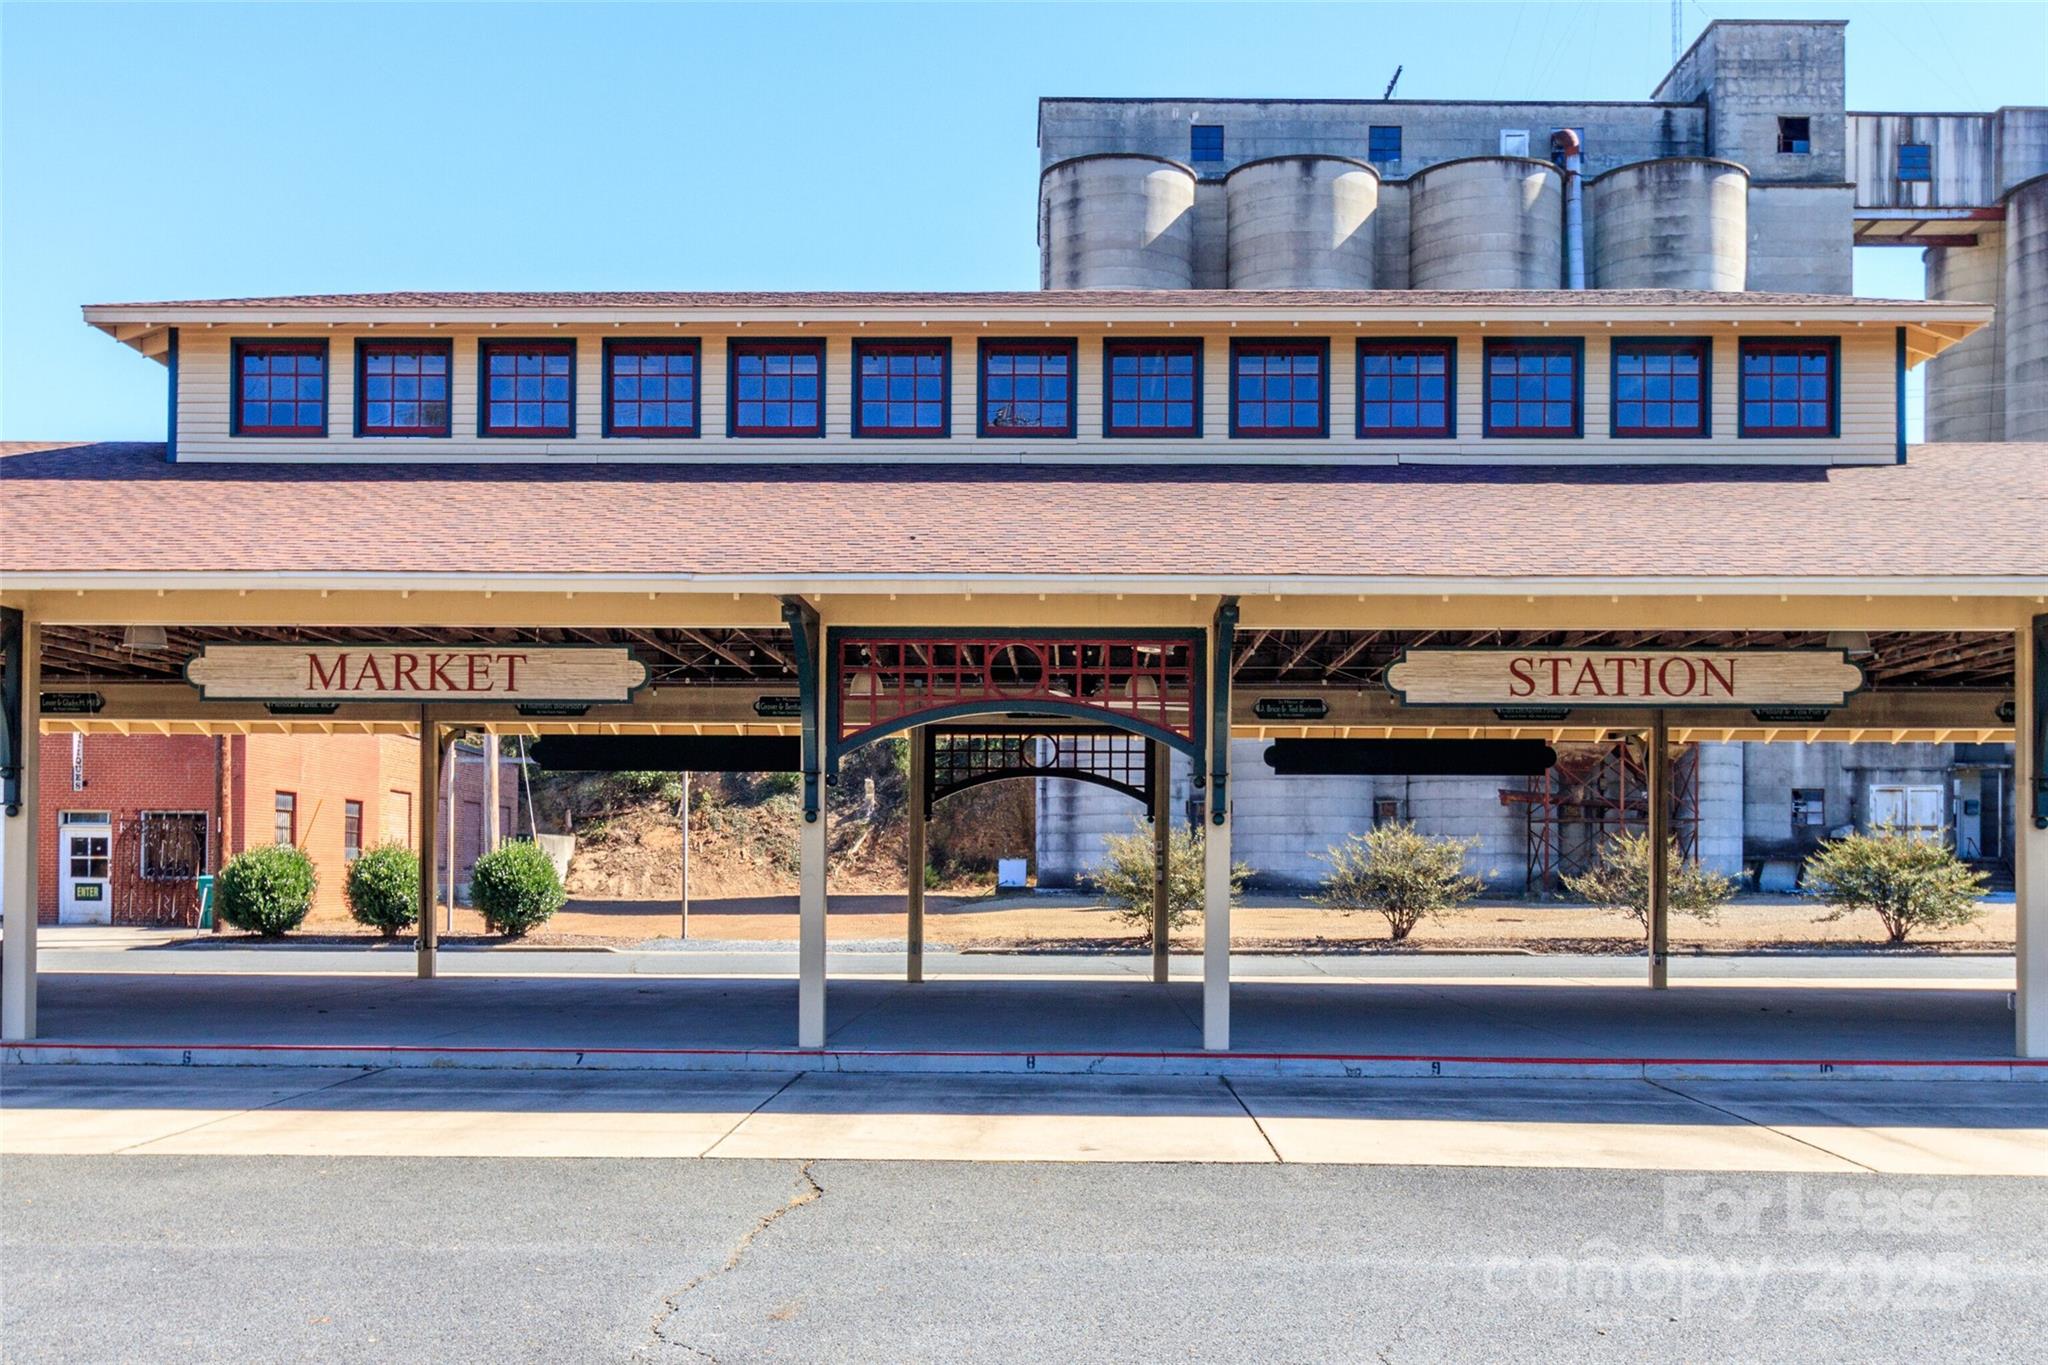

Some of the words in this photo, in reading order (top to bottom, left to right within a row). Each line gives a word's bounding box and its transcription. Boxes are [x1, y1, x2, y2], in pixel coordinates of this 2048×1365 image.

[305, 653, 528, 691] MARKET
[1509, 656, 1739, 697] STATION
[77, 886, 99, 897] ENTER
[576, 1052, 584, 1065] 7
[1026, 1056, 1036, 1069] 8
[1431, 1061, 1441, 1075] 9
